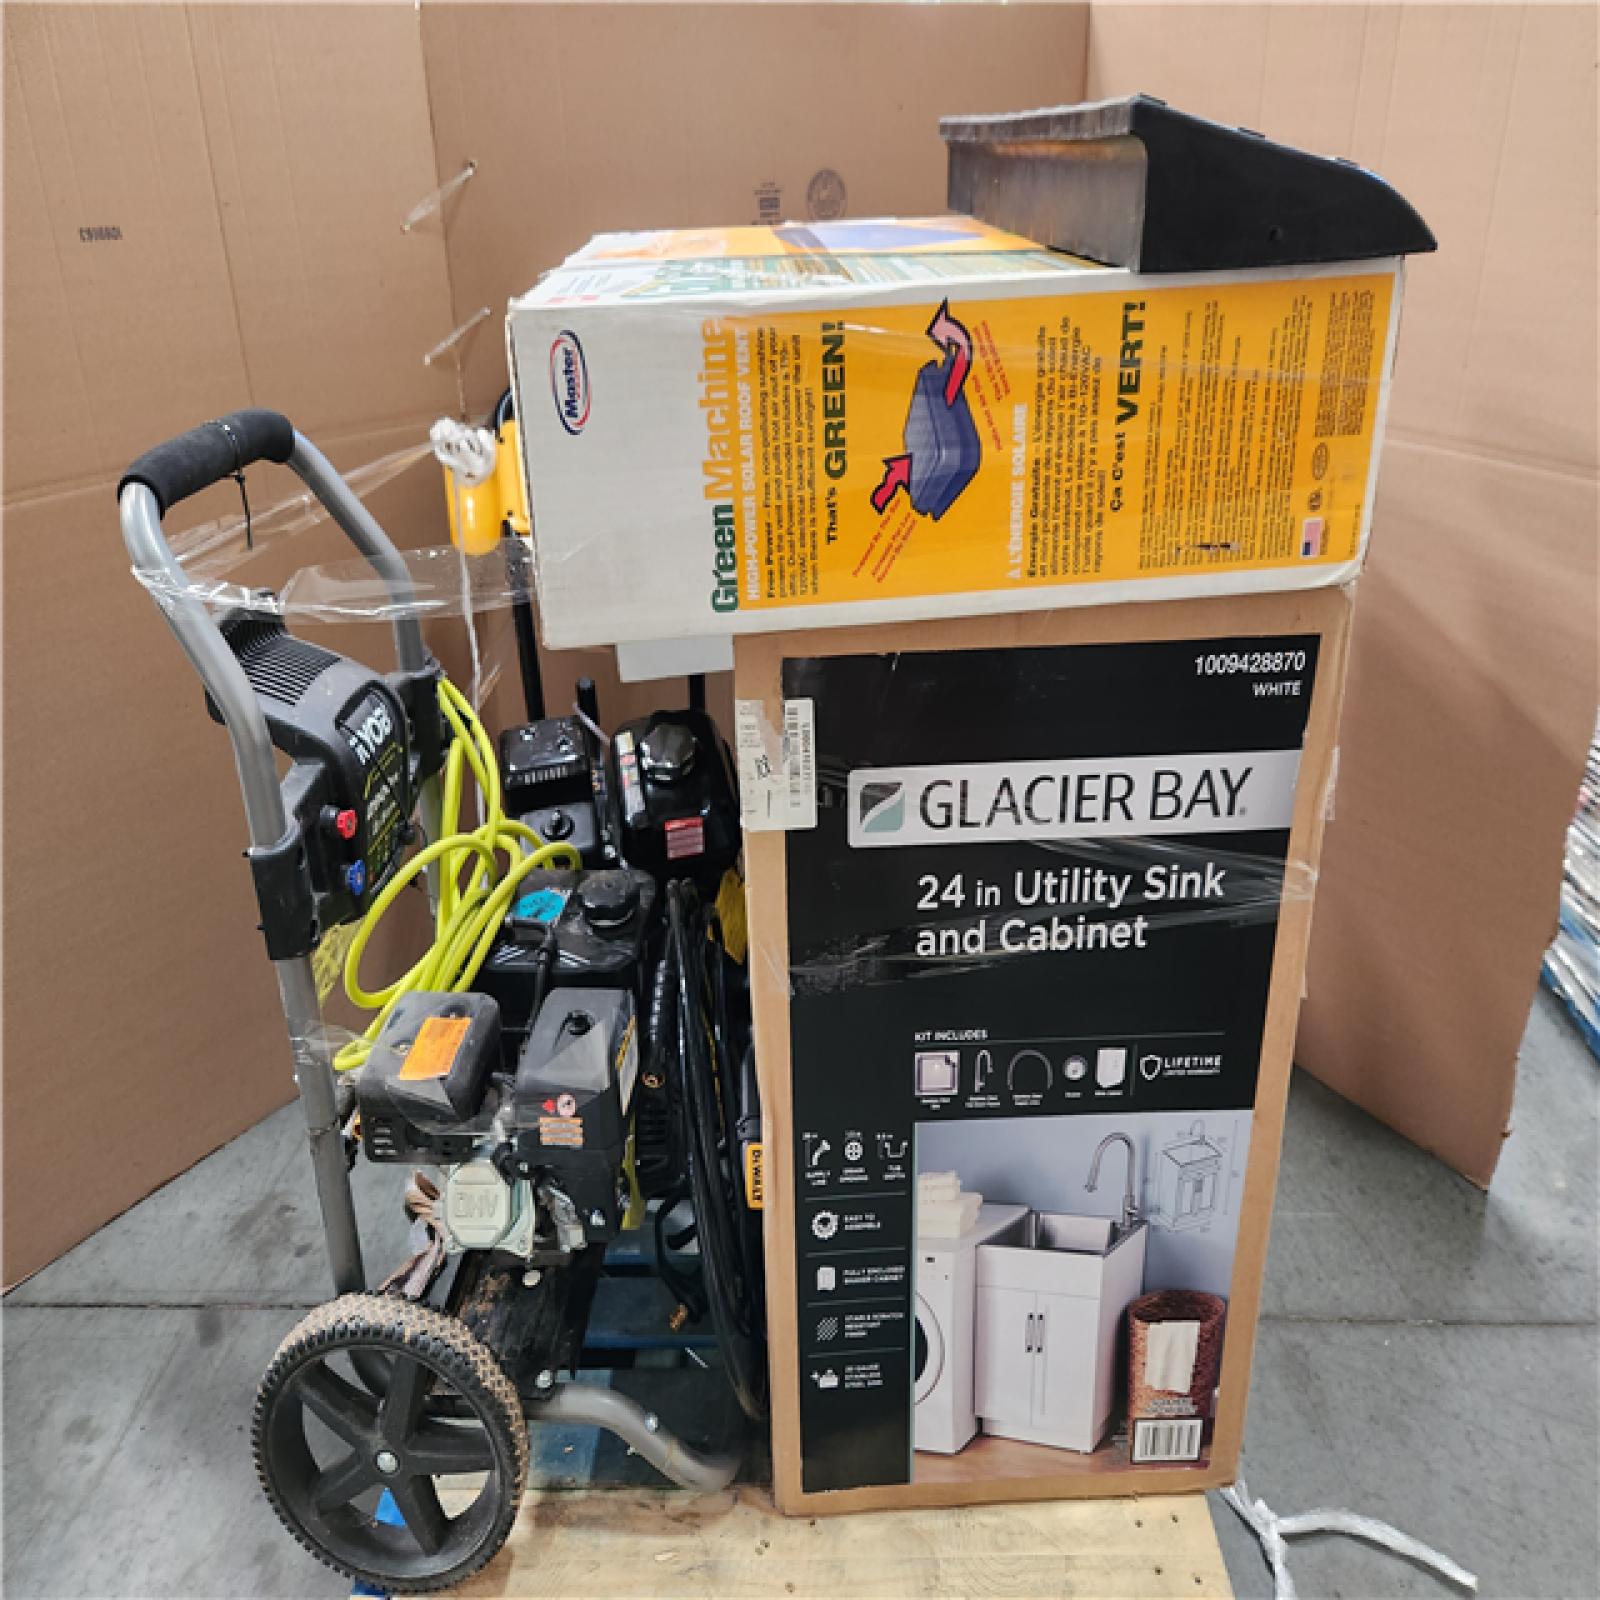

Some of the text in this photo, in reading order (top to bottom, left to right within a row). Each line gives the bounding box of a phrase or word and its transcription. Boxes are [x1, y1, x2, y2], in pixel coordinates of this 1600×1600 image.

[562, 348, 577, 418] Master
[1114, 301, 1145, 425] VERT!
[822, 320, 847, 544] That's GREEN!
[1012, 404, 1028, 476] SOLAIRE
[698, 320, 738, 613] Green Machine
[735, 329, 760, 600] HIGH-POWER SOLAR ROOF VENT
[1030, 458, 1040, 518] Gratuite
[765, 523, 773, 565] Power
[1194, 651, 1306, 676] 1009428870
[1252, 680, 1302, 697] WHITE
[349, 702, 388, 765] RYOB
[919, 767, 1253, 830] GLACIER BAY
[916, 862, 1226, 910] 24 in Utility Sink
[916, 916, 1148, 956] and Cabinet
[914, 1029, 988, 1042] KIT INCLUDES
[1163, 1055, 1221, 1068] LIFETIME
